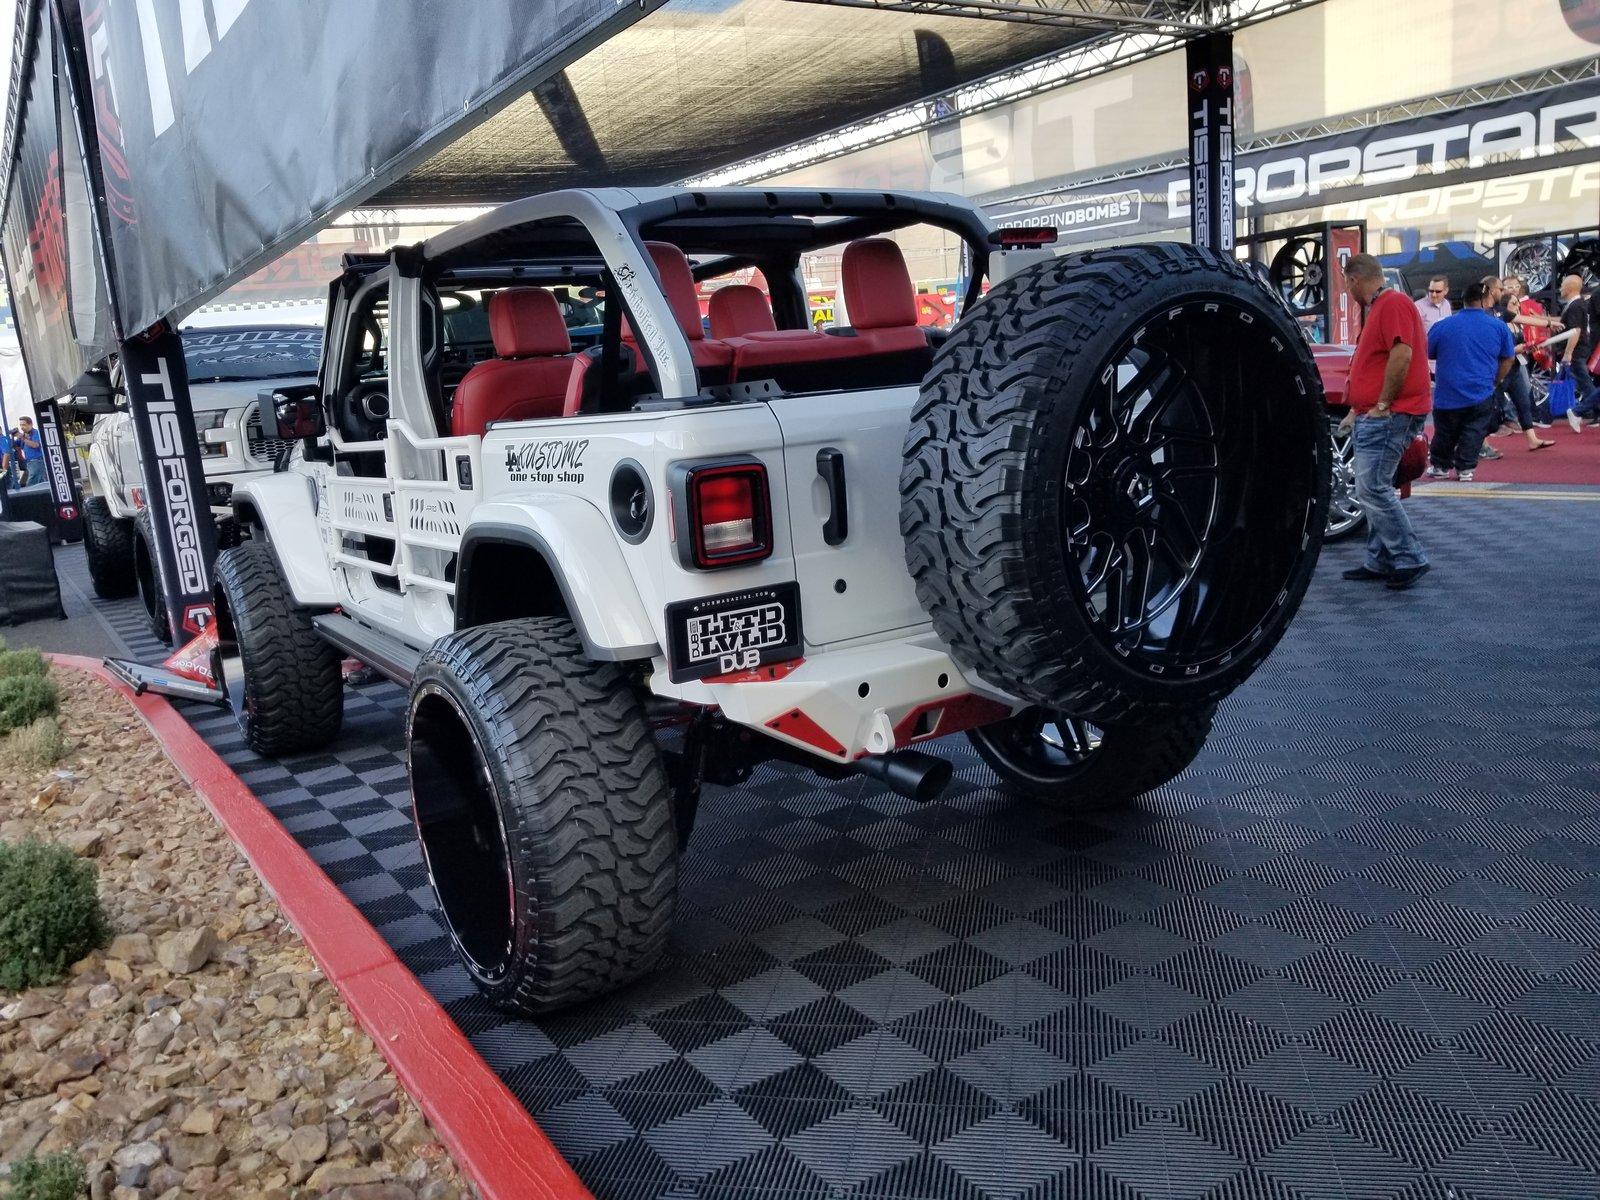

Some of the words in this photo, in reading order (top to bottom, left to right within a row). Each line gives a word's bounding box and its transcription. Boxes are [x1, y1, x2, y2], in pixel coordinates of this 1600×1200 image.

[510, 473, 528, 482] one
[530, 471, 554, 484] stop
[557, 471, 585, 484] shop
[720, 648, 761, 674] DUB
